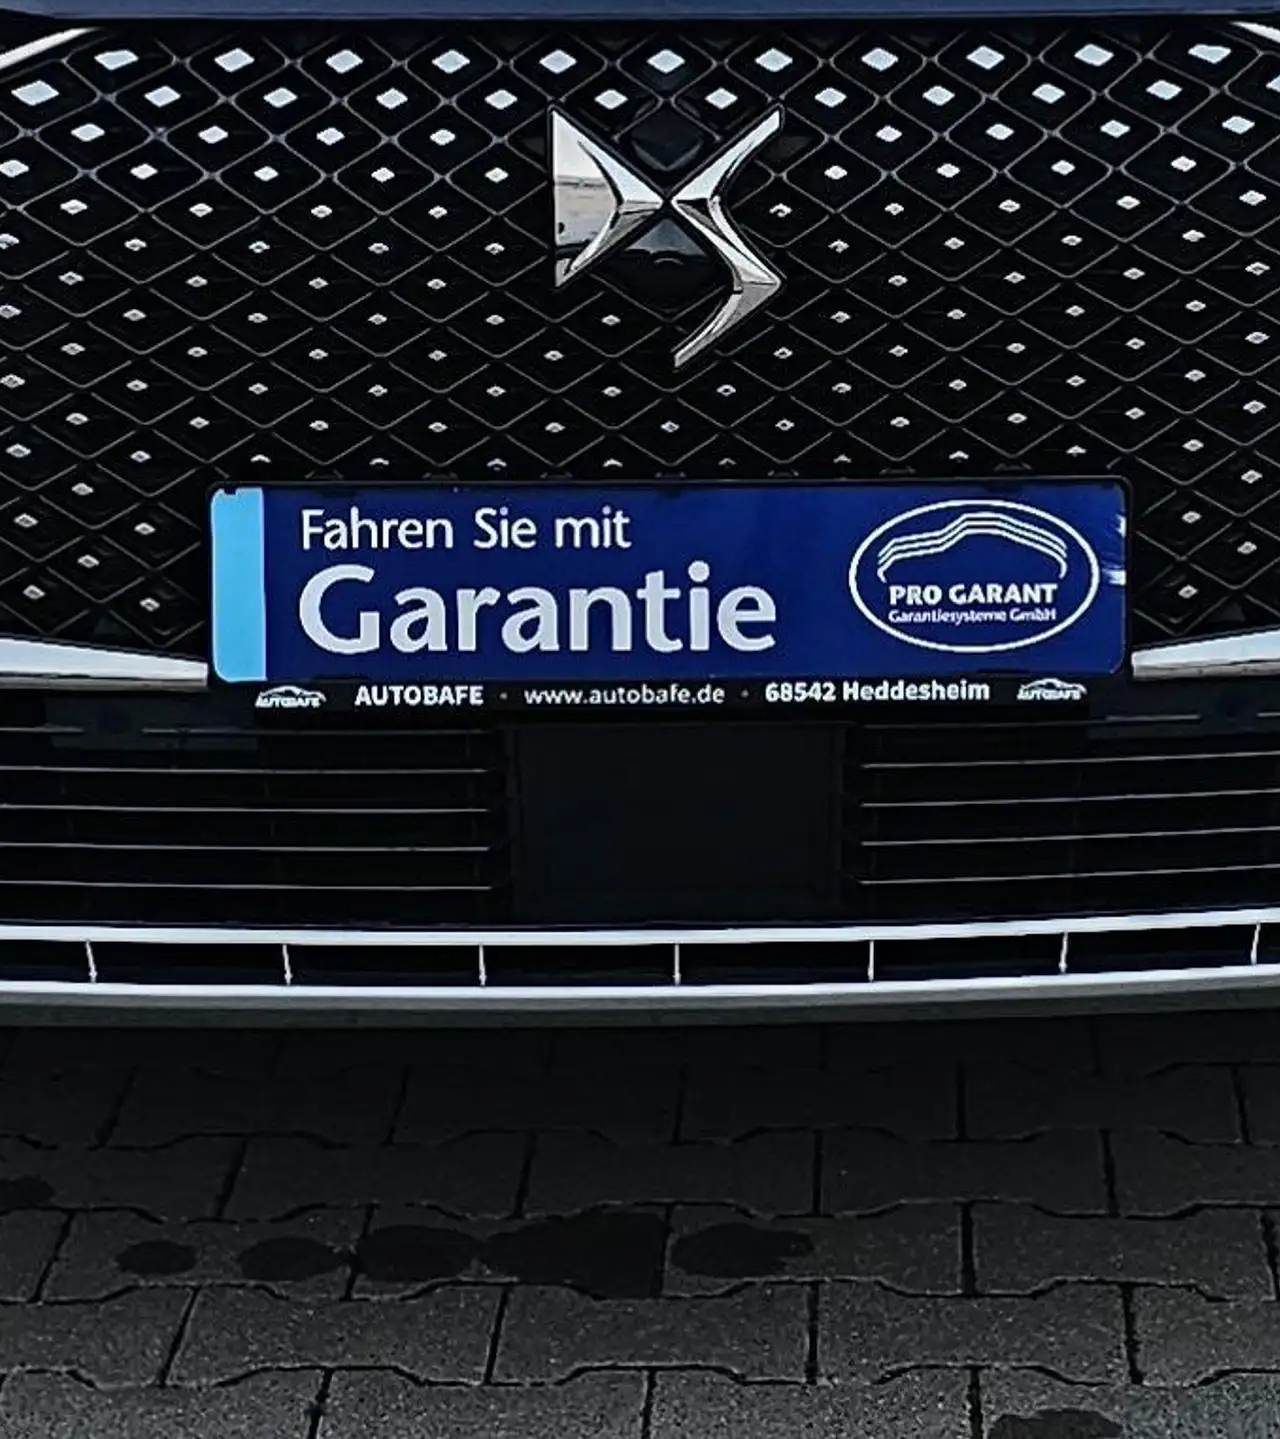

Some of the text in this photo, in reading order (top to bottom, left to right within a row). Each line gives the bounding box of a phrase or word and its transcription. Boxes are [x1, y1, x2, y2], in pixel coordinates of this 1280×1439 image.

[301, 505, 632, 550] Fahren Sie mit
[299, 560, 777, 654] Garantie
[889, 583, 1058, 605] PRO GARANT
[888, 607, 1057, 627] Garantiesysteme GmbH
[354, 679, 991, 706] AUTOBAFE www.autobafe.de 68542 Heddesheim
